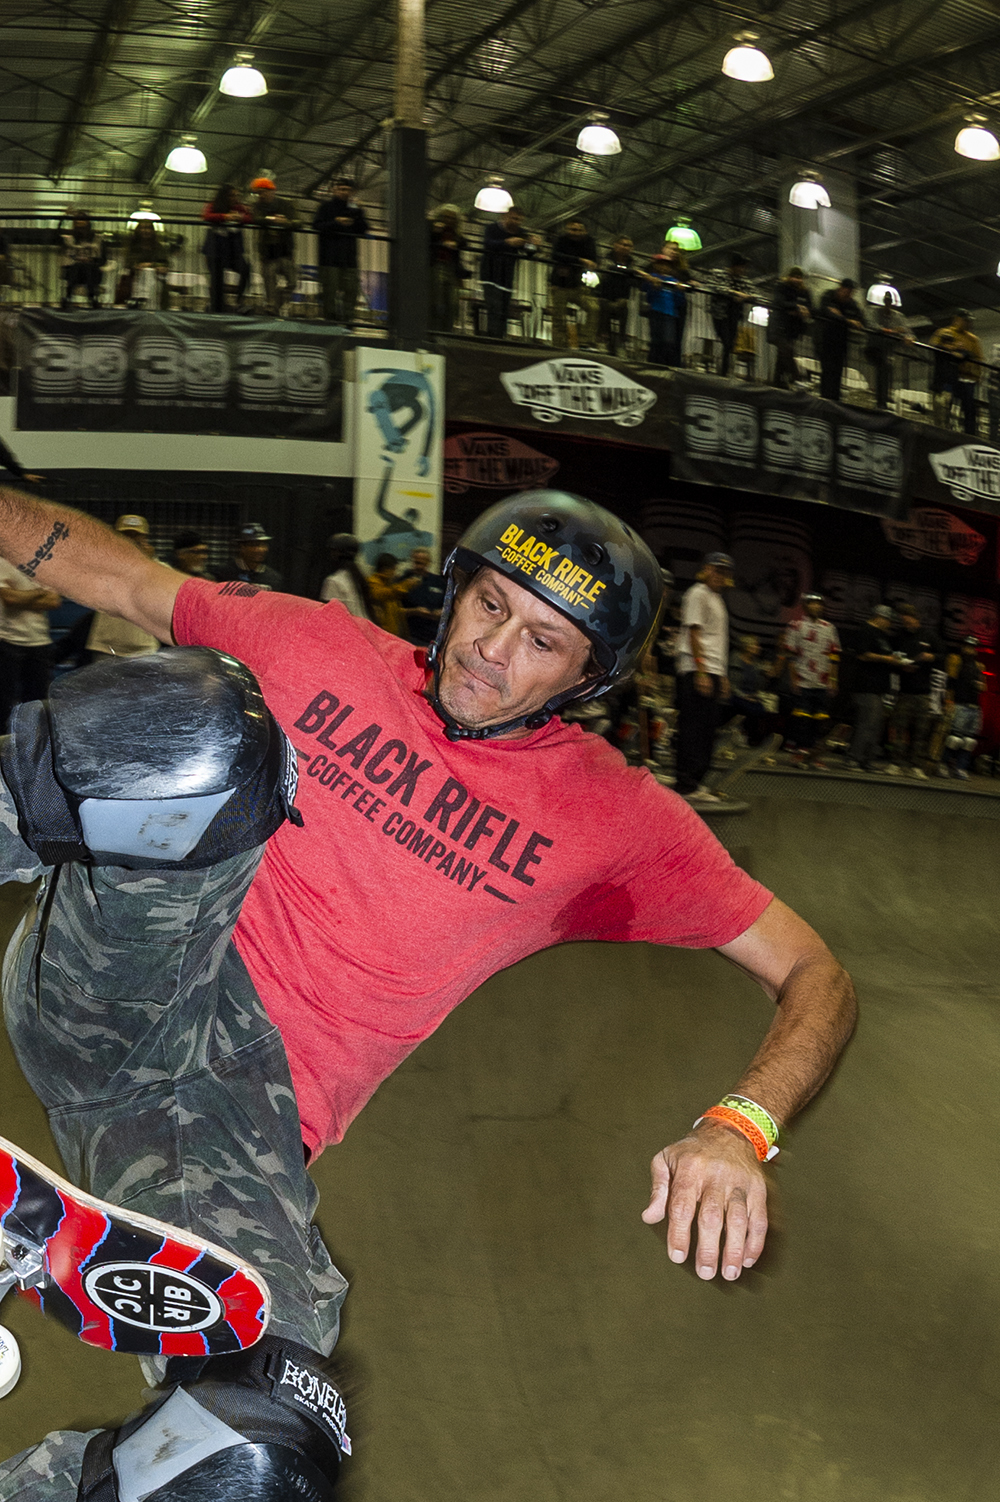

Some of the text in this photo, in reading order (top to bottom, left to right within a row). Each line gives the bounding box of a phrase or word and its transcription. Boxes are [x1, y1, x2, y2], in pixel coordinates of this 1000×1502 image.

[548, 362, 605, 386] VANS
[555, 384, 597, 413] THE
[456, 436, 511, 457] VANS
[499, 523, 607, 603] BLACK RIFLE
[501, 547, 584, 607] COFFEE COMPANY
[293, 689, 554, 887] BLACK RIFLE
[306, 754, 488, 893] COFFEE COMPANY
[293, 1393, 318, 1413] SKATE
